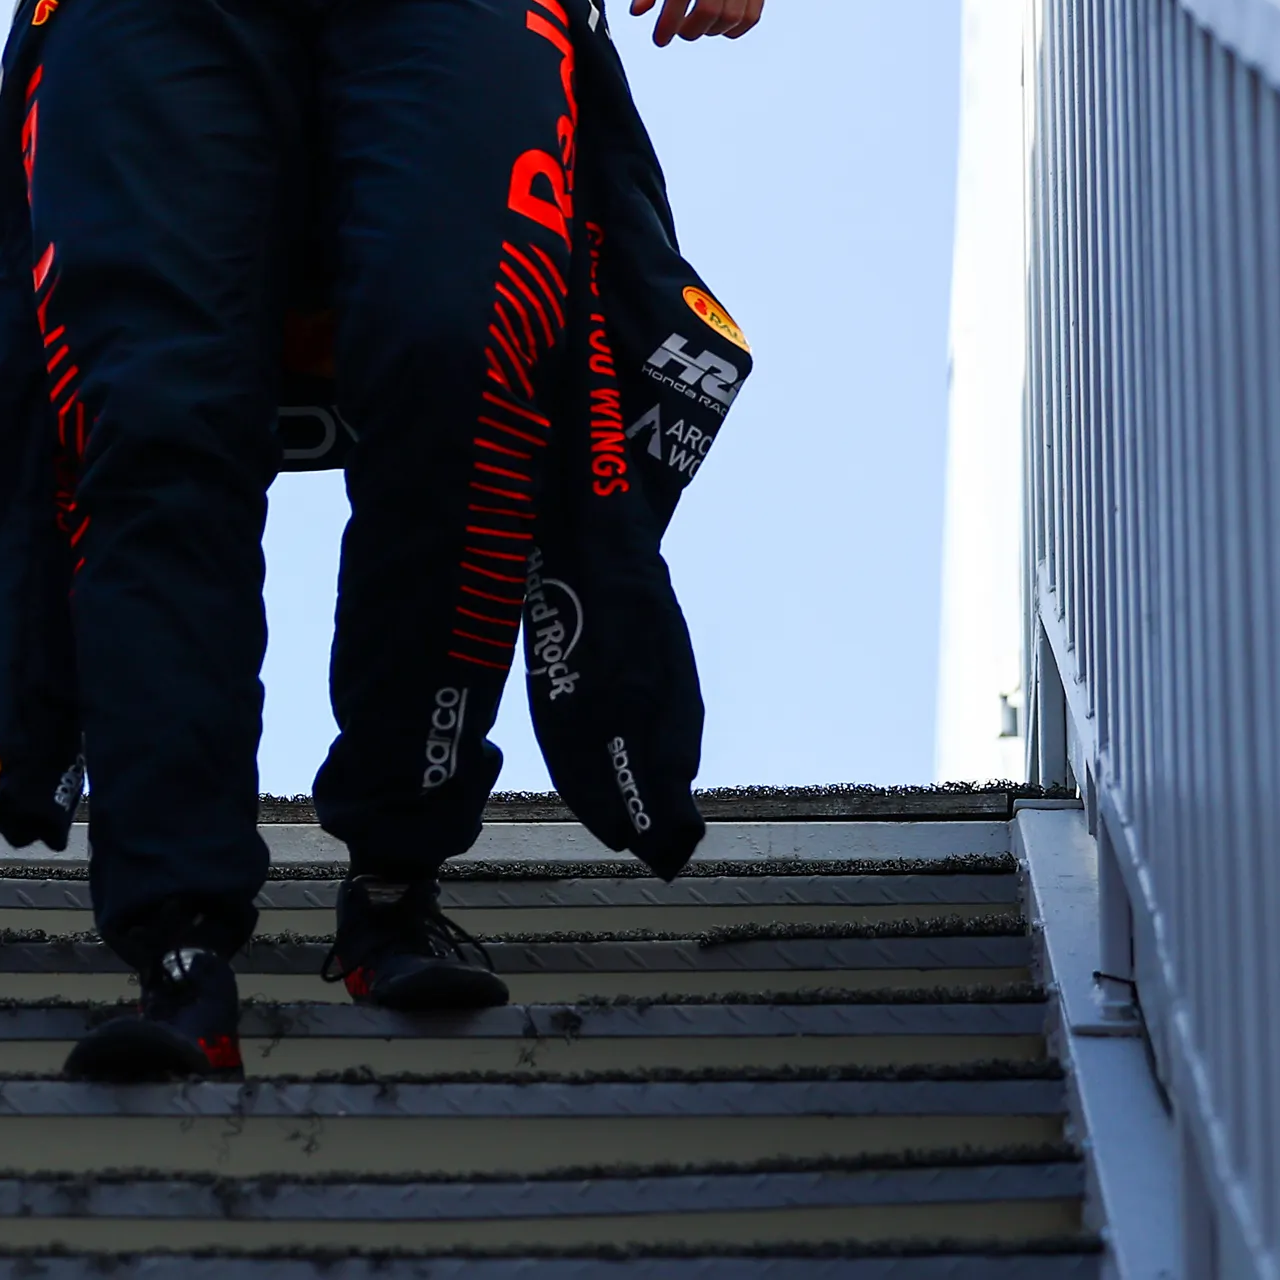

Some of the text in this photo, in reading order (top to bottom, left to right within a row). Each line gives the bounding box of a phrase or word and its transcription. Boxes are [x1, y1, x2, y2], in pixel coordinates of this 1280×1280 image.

[641, 364, 697, 401] Honda
[590, 387, 631, 497] WINGS
[533, 619, 581, 702] Rock
[420, 685, 460, 790] parco
[605, 735, 652, 833] sparco
